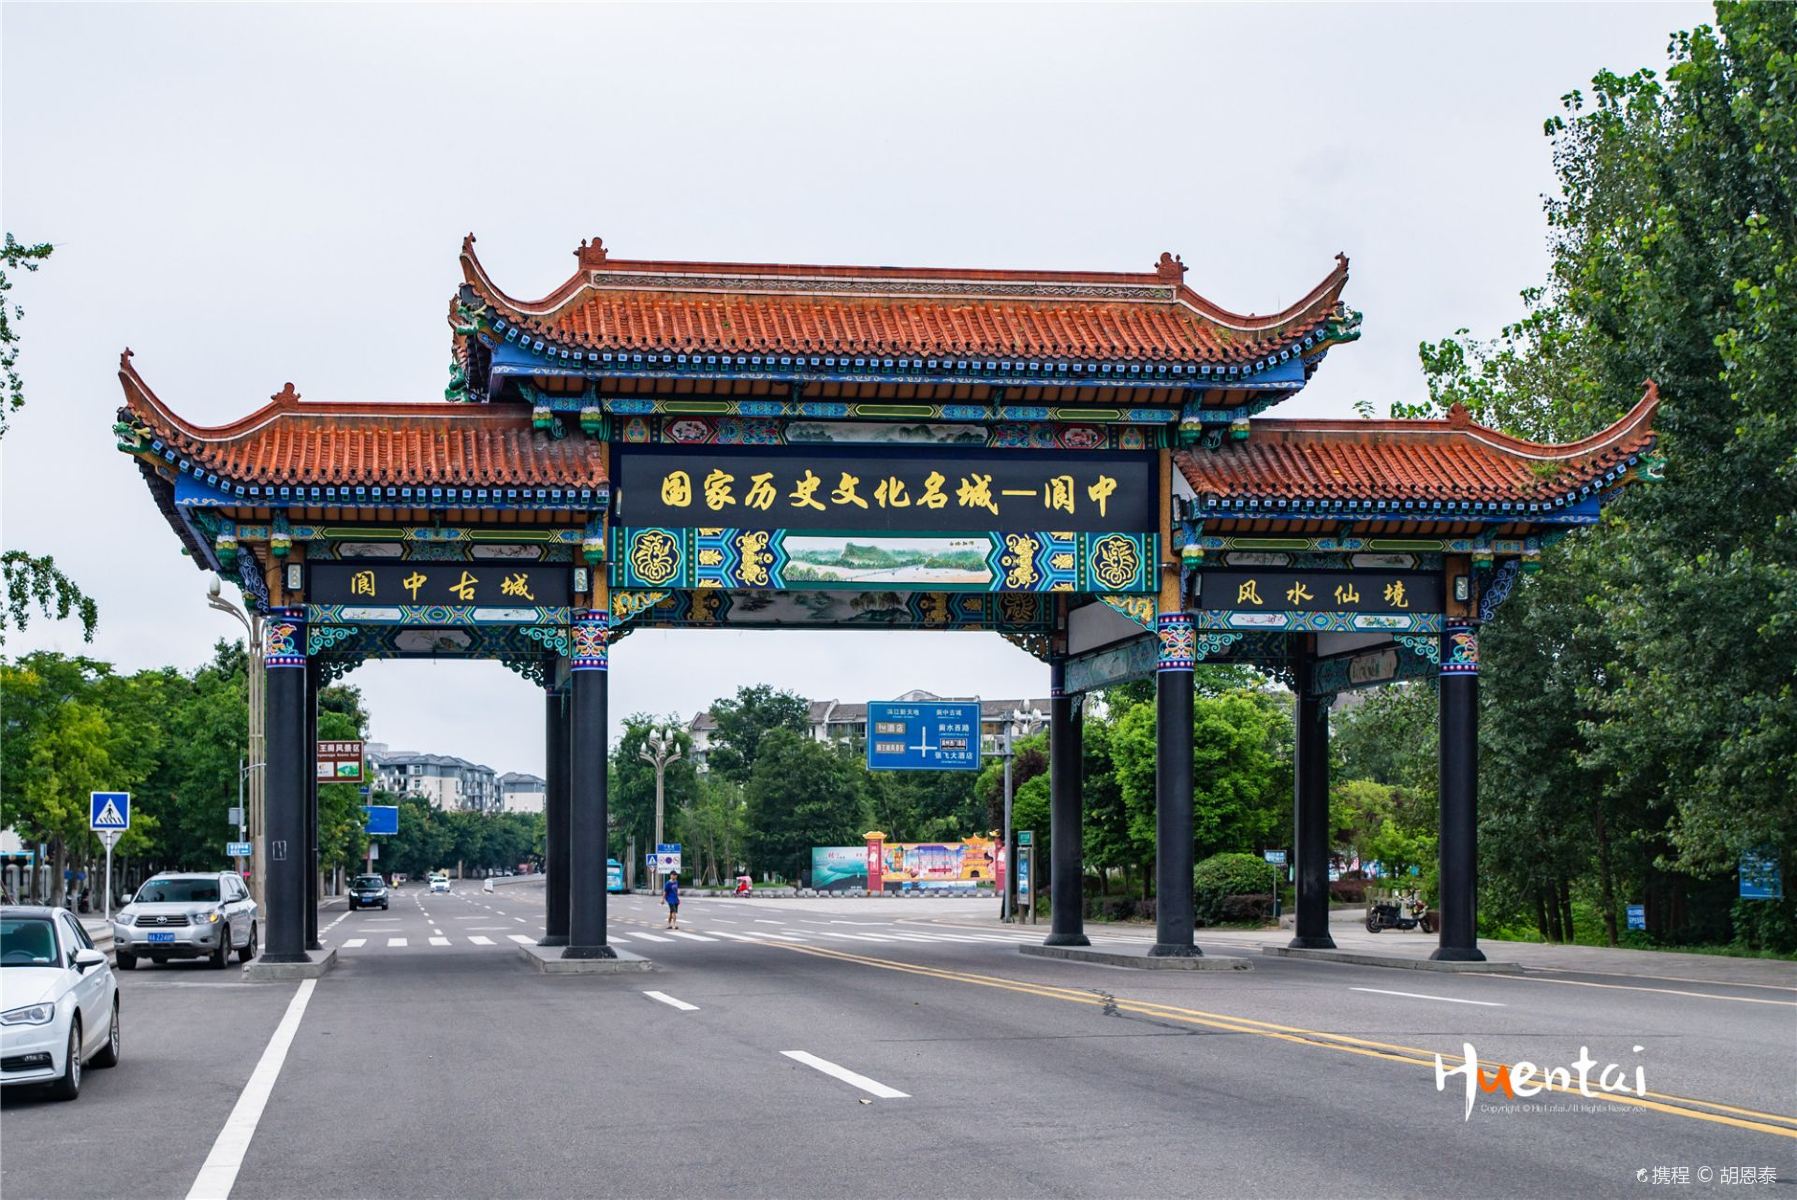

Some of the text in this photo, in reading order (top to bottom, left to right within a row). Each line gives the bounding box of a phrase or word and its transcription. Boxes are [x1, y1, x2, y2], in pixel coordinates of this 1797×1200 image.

[351, 570, 534, 600] 阆中古城
[1237, 579, 1408, 608] 风水仙境
